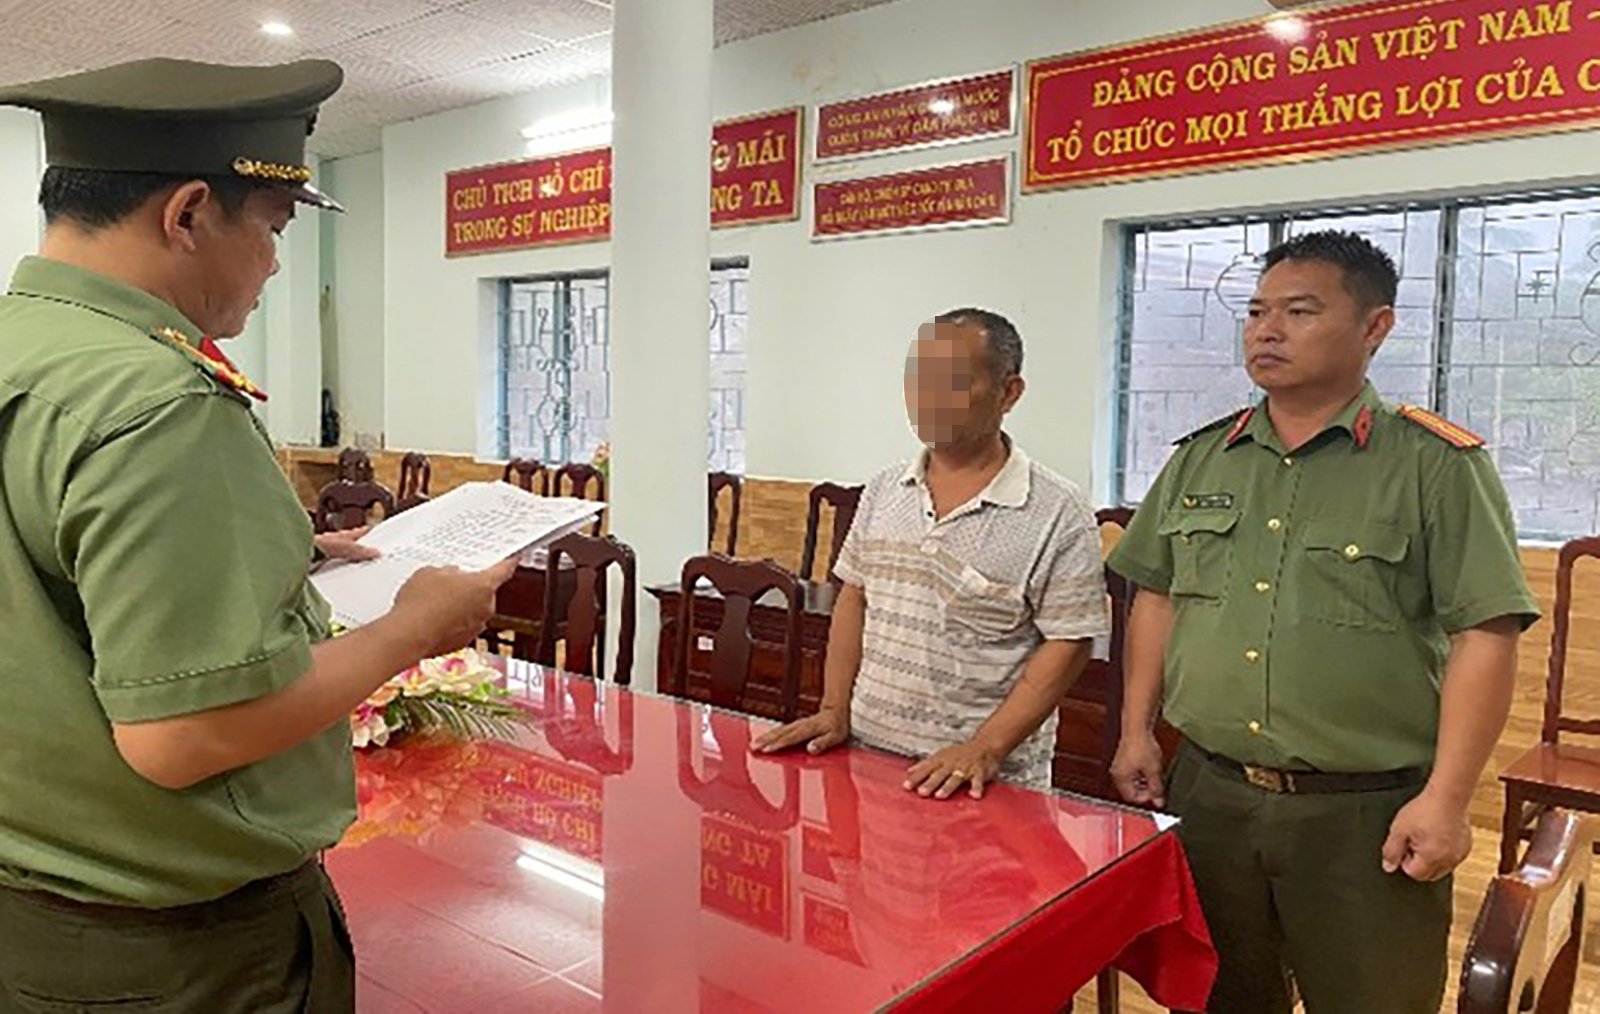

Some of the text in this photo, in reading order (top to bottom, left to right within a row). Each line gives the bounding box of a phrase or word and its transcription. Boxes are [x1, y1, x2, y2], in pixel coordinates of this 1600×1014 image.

[1092, 67, 1176, 107] ĐẢNG
[1186, 53, 1277, 93] CỘNG
[1288, 30, 1359, 75] SẢN
[1371, 16, 1465, 60] VIỆT
[1477, 1, 1572, 45] NAM
[1046, 119, 1083, 163] TỔ
[1093, 117, 1176, 156] CHỨC
[1185, 110, 1248, 145] MỌI
[1258, 83, 1383, 134] THẮNG
[1395, 76, 1462, 118] LỢI
[1476, 57, 1564, 104] CỦA
[453, 178, 487, 212] CHỦ
[569, 159, 605, 194] CHÍ
[736, 129, 787, 168] MÁI
[453, 215, 508, 244] TRONG
[511, 209, 537, 240] SỰ
[539, 198, 611, 233] NGHIỆP
[751, 179, 784, 206] TA
